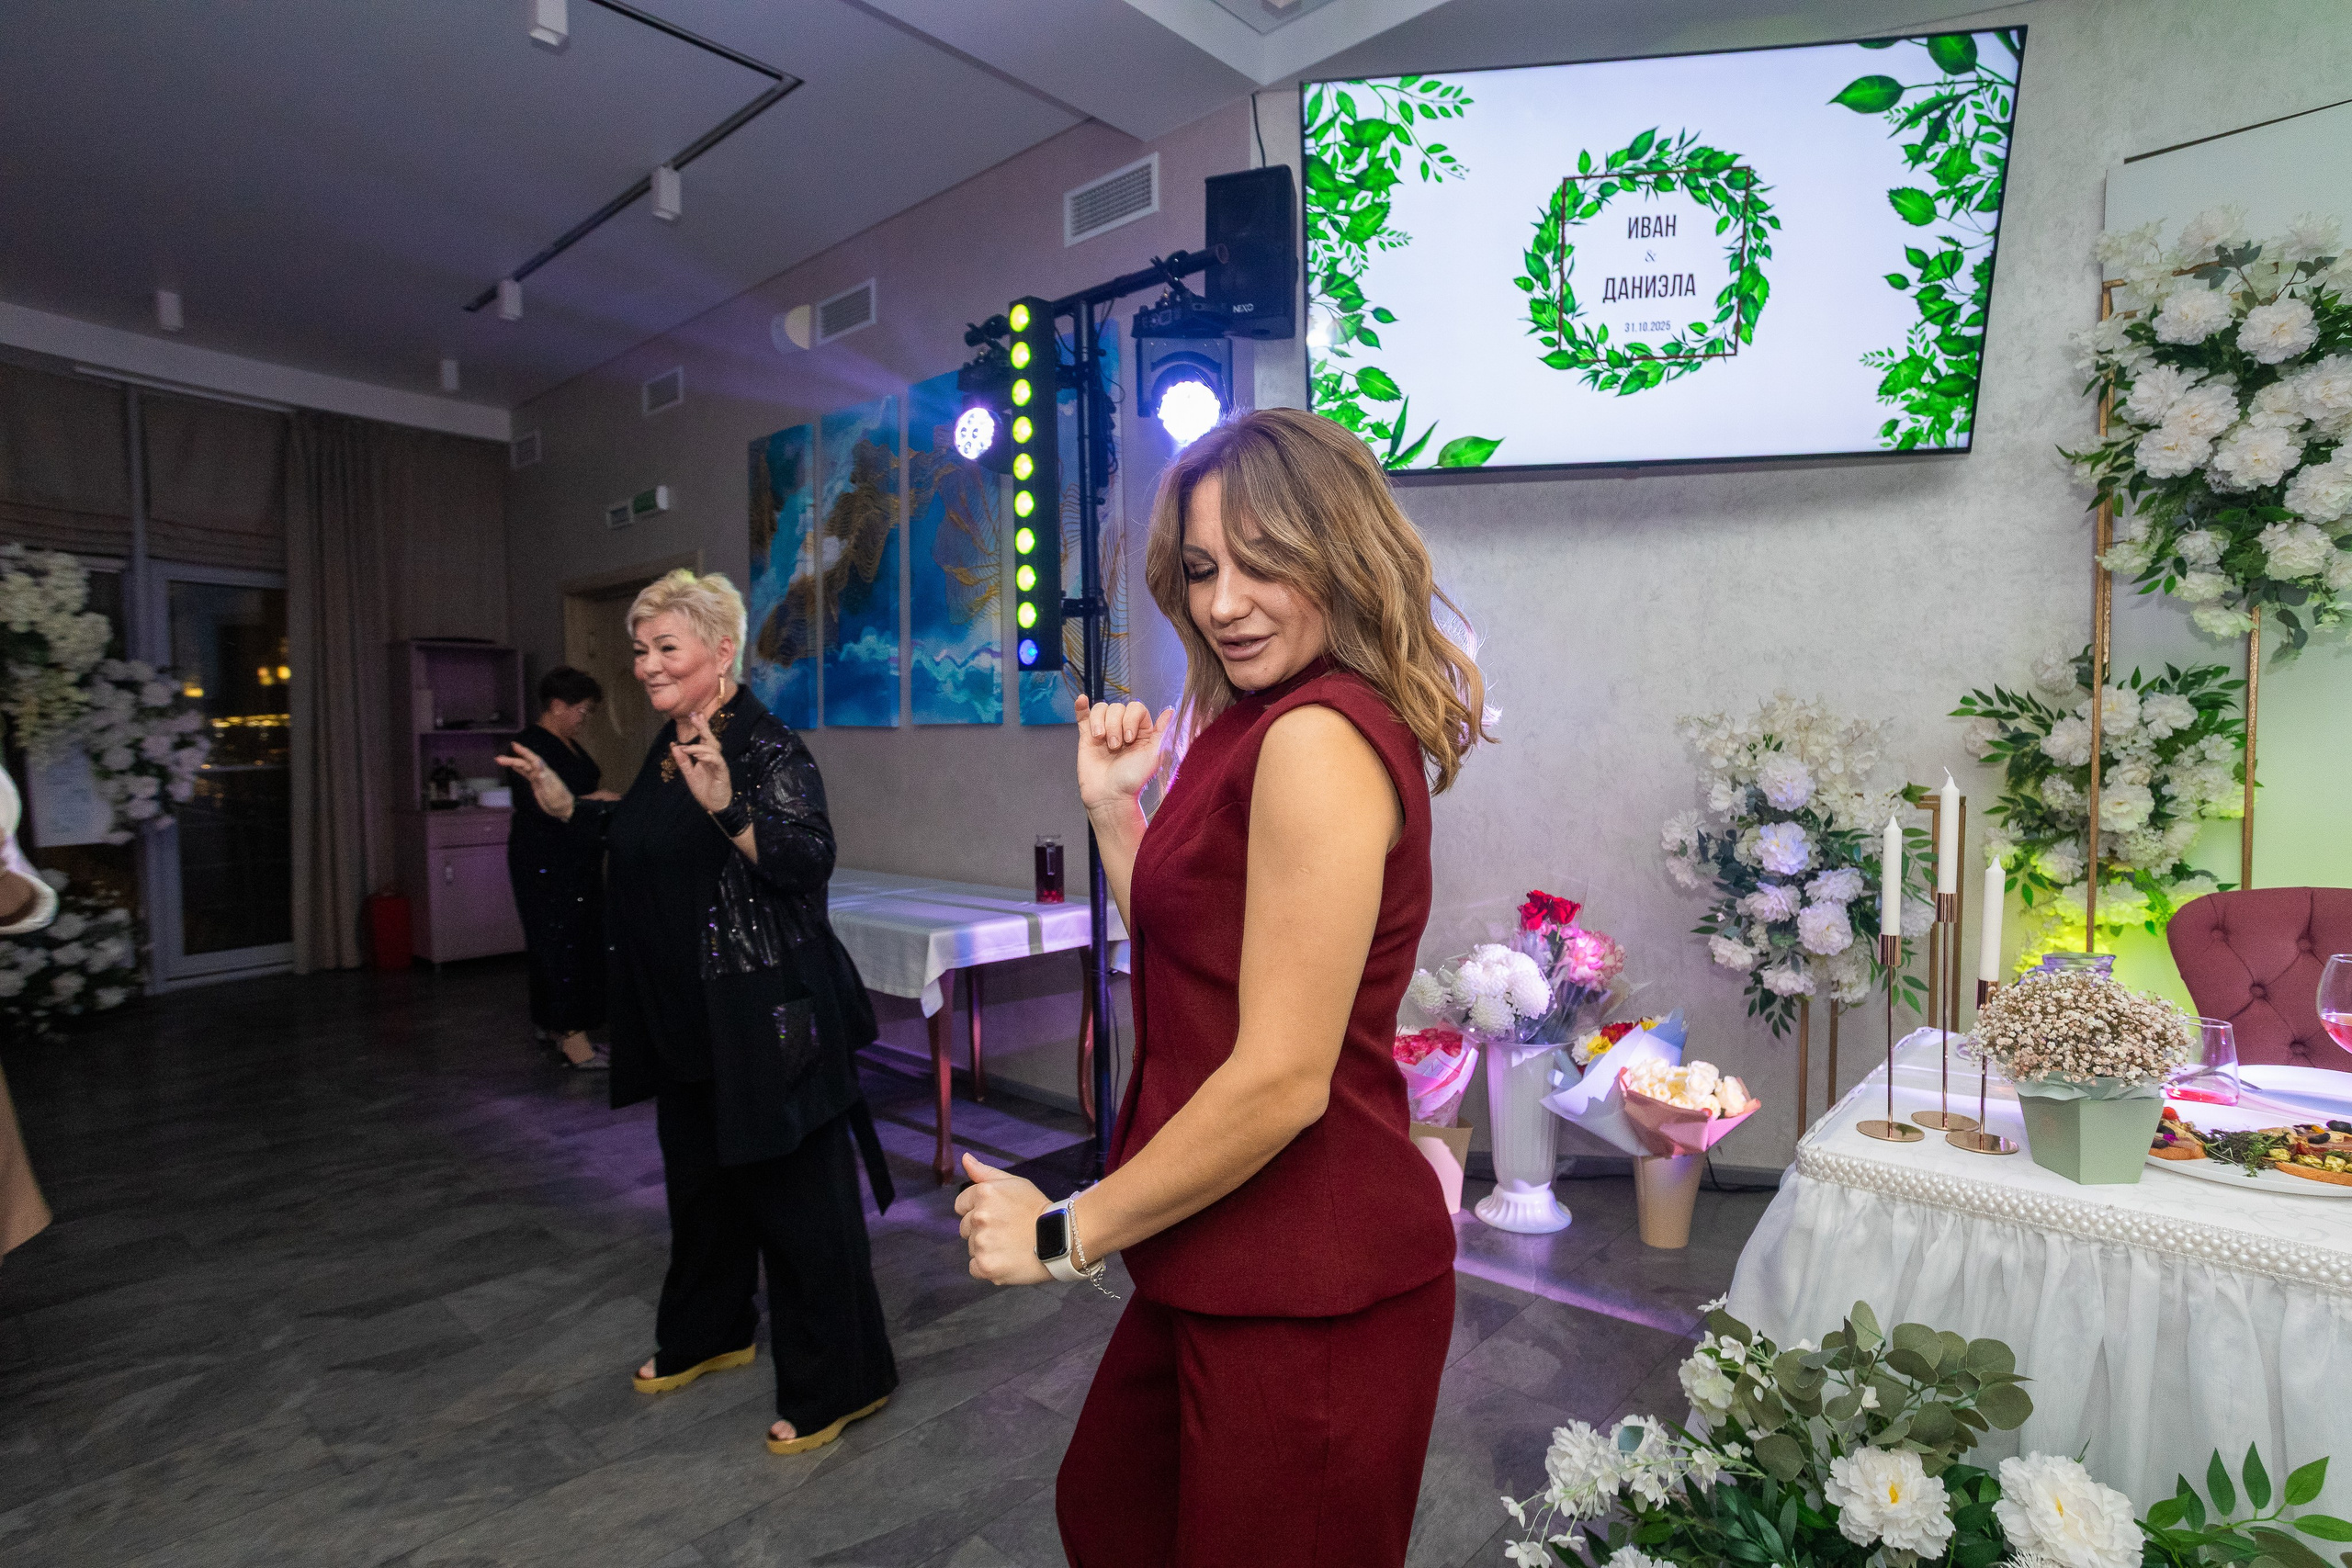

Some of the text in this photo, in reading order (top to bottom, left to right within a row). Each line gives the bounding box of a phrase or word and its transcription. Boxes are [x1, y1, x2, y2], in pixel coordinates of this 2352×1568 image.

[1628, 215, 1677, 239] ИВАН
[1645, 250, 1656, 263] &
[1602, 274, 1696, 303] ДАНИЭЛА
[1232, 303, 1254, 313] NEXO
[1624, 321, 1671, 333] 31.10.2025
